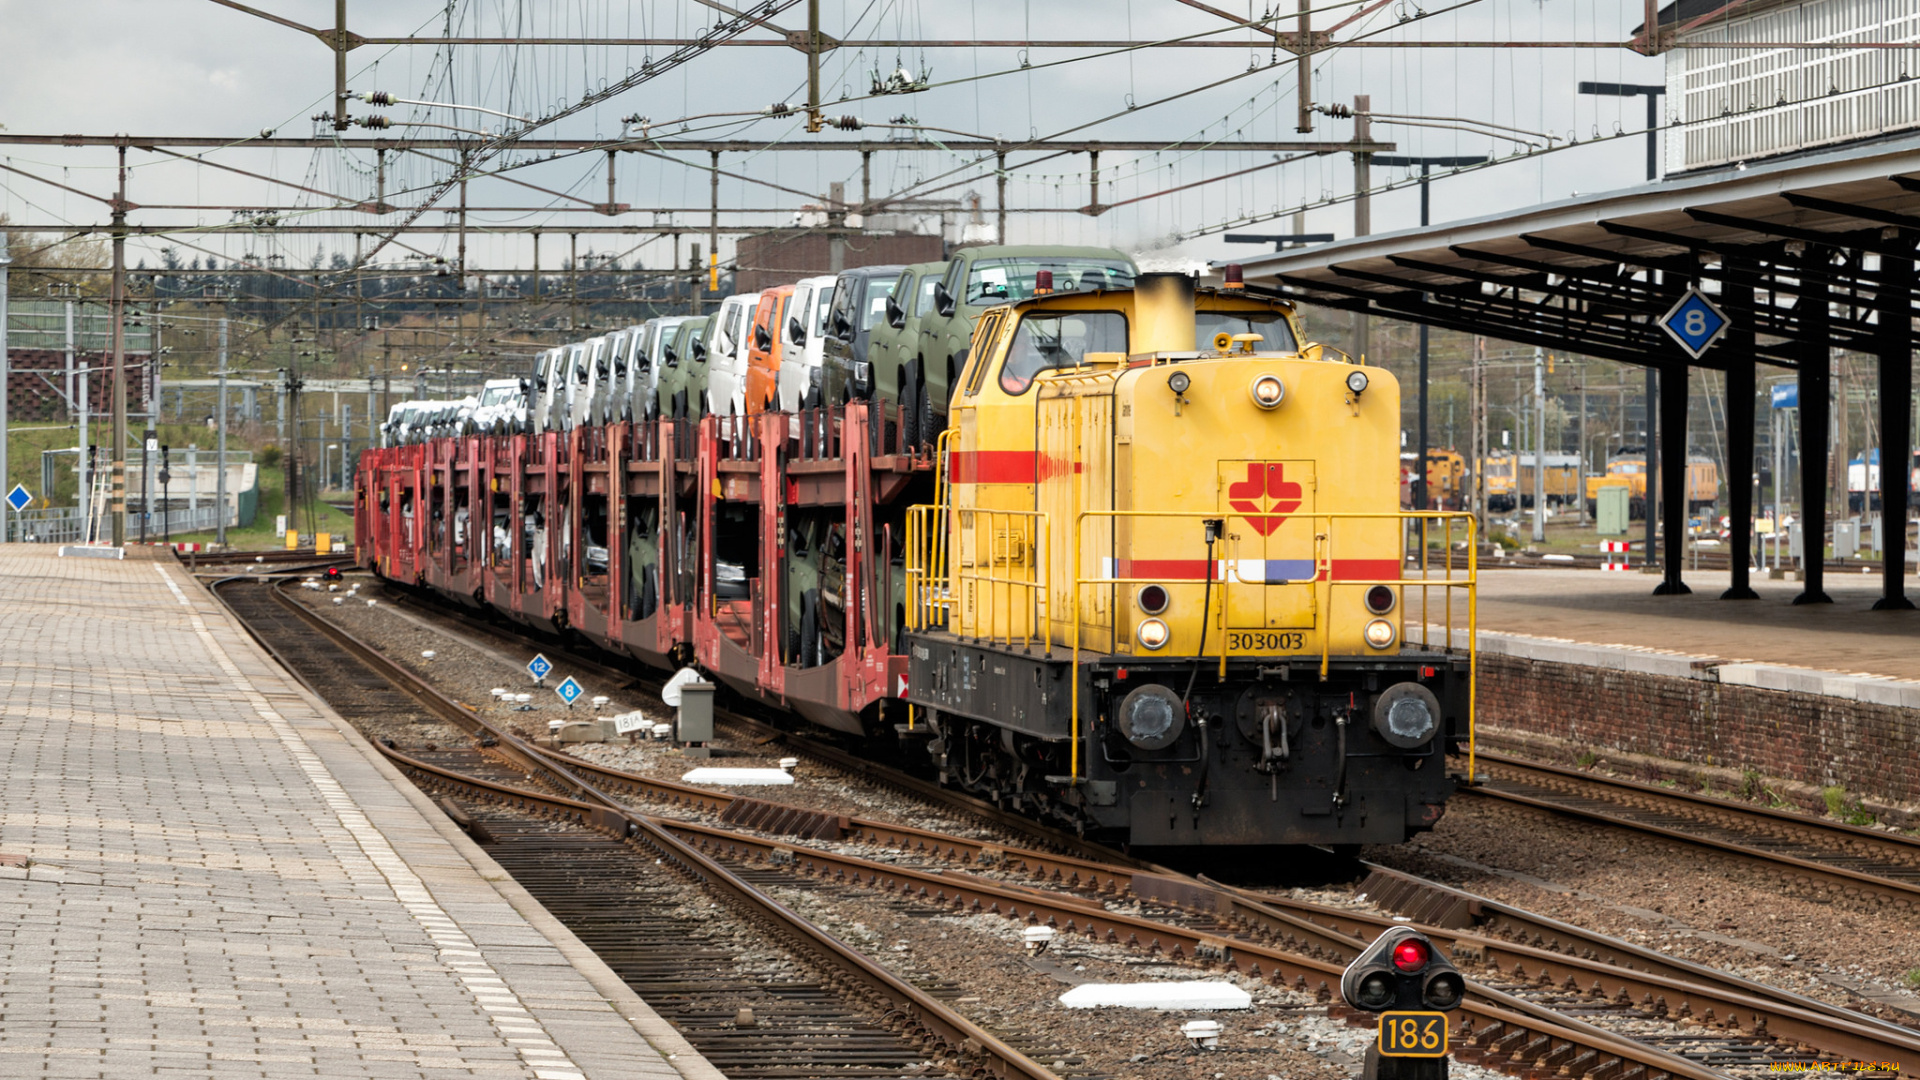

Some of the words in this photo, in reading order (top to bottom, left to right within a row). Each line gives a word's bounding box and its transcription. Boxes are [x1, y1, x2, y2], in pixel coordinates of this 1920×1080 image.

[1685, 309, 1706, 336] 8
[1229, 633, 1303, 650] 303003
[533, 662, 546, 672] 12
[565, 684, 574, 697] 8
[618, 715, 640, 729] 181A
[1388, 1019, 1439, 1049] 186
